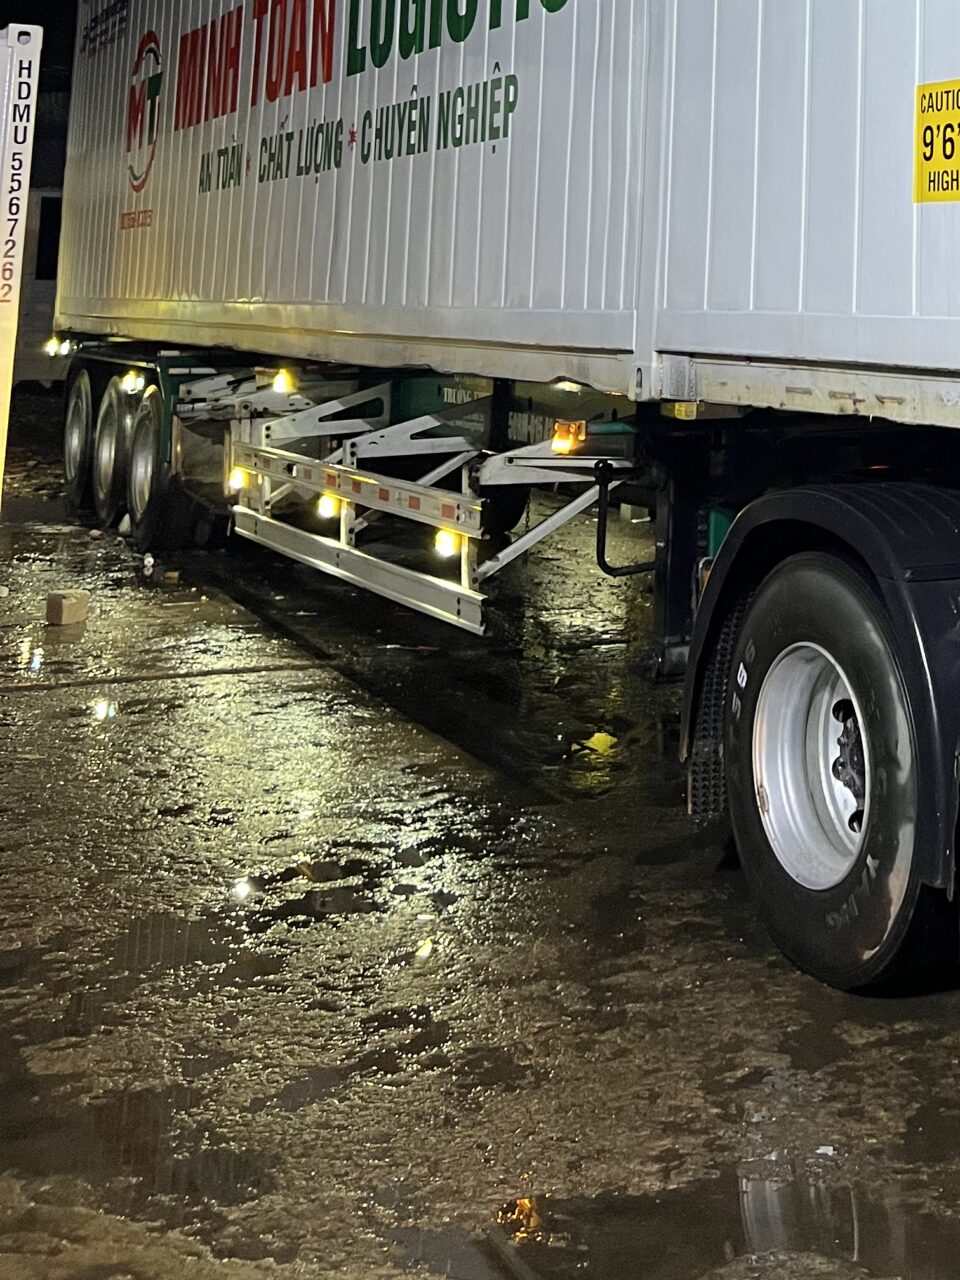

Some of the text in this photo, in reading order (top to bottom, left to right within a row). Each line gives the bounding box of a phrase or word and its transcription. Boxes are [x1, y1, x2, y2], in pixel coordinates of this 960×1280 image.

[126, 71, 164, 153] MT
[174, 4, 243, 132] MINH
[198, 150, 213, 195] AN
[258, 114, 295, 184] CHẤT
[361, 84, 431, 165] CHUYÊN
[436, 61, 519, 154] NGHIỆP
[927, 169, 959, 193] HIGH
